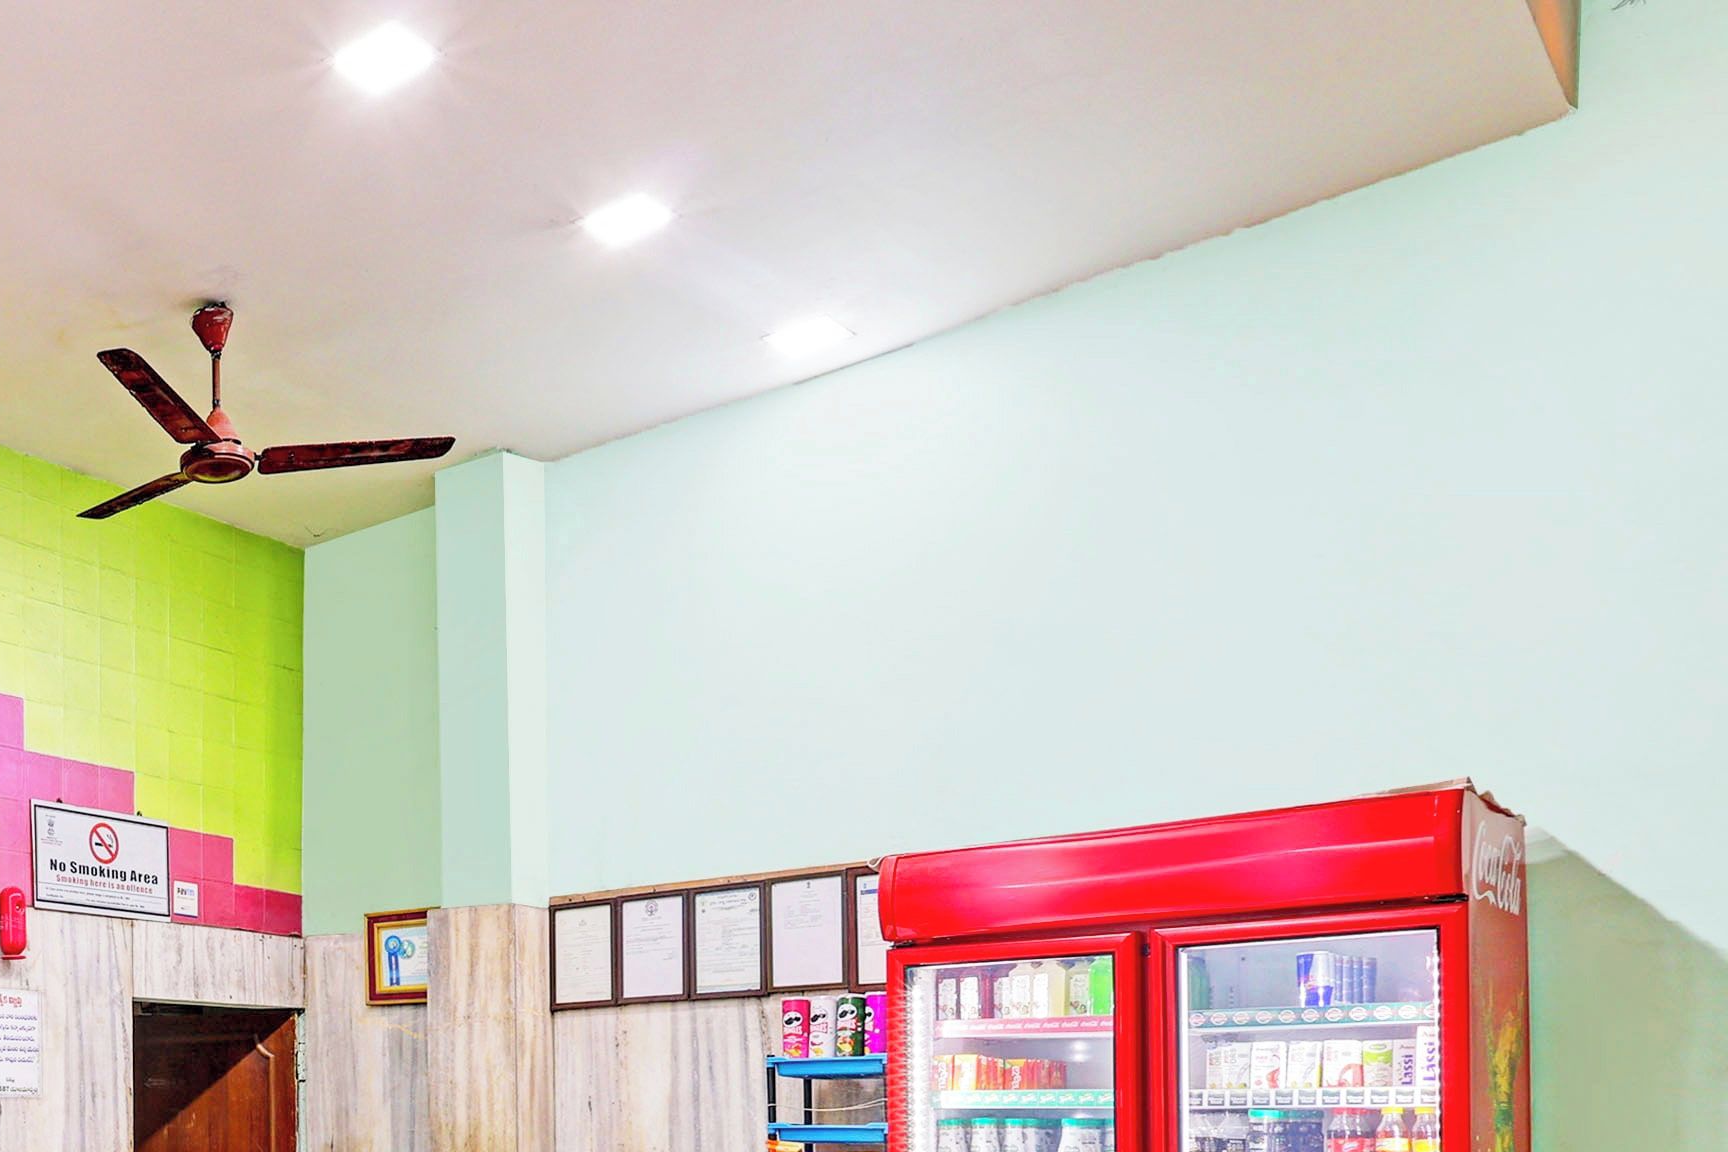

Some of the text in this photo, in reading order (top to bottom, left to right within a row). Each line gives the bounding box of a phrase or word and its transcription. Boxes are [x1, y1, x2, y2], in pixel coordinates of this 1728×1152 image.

[50, 858, 159, 885] No Smoking Area
[56, 874, 88, 887] Smoking
[90, 880, 107, 889] here
[108, 881, 115, 889] is
[126, 883, 153, 895] offence
[1401, 1054, 1413, 1085] Lassi
